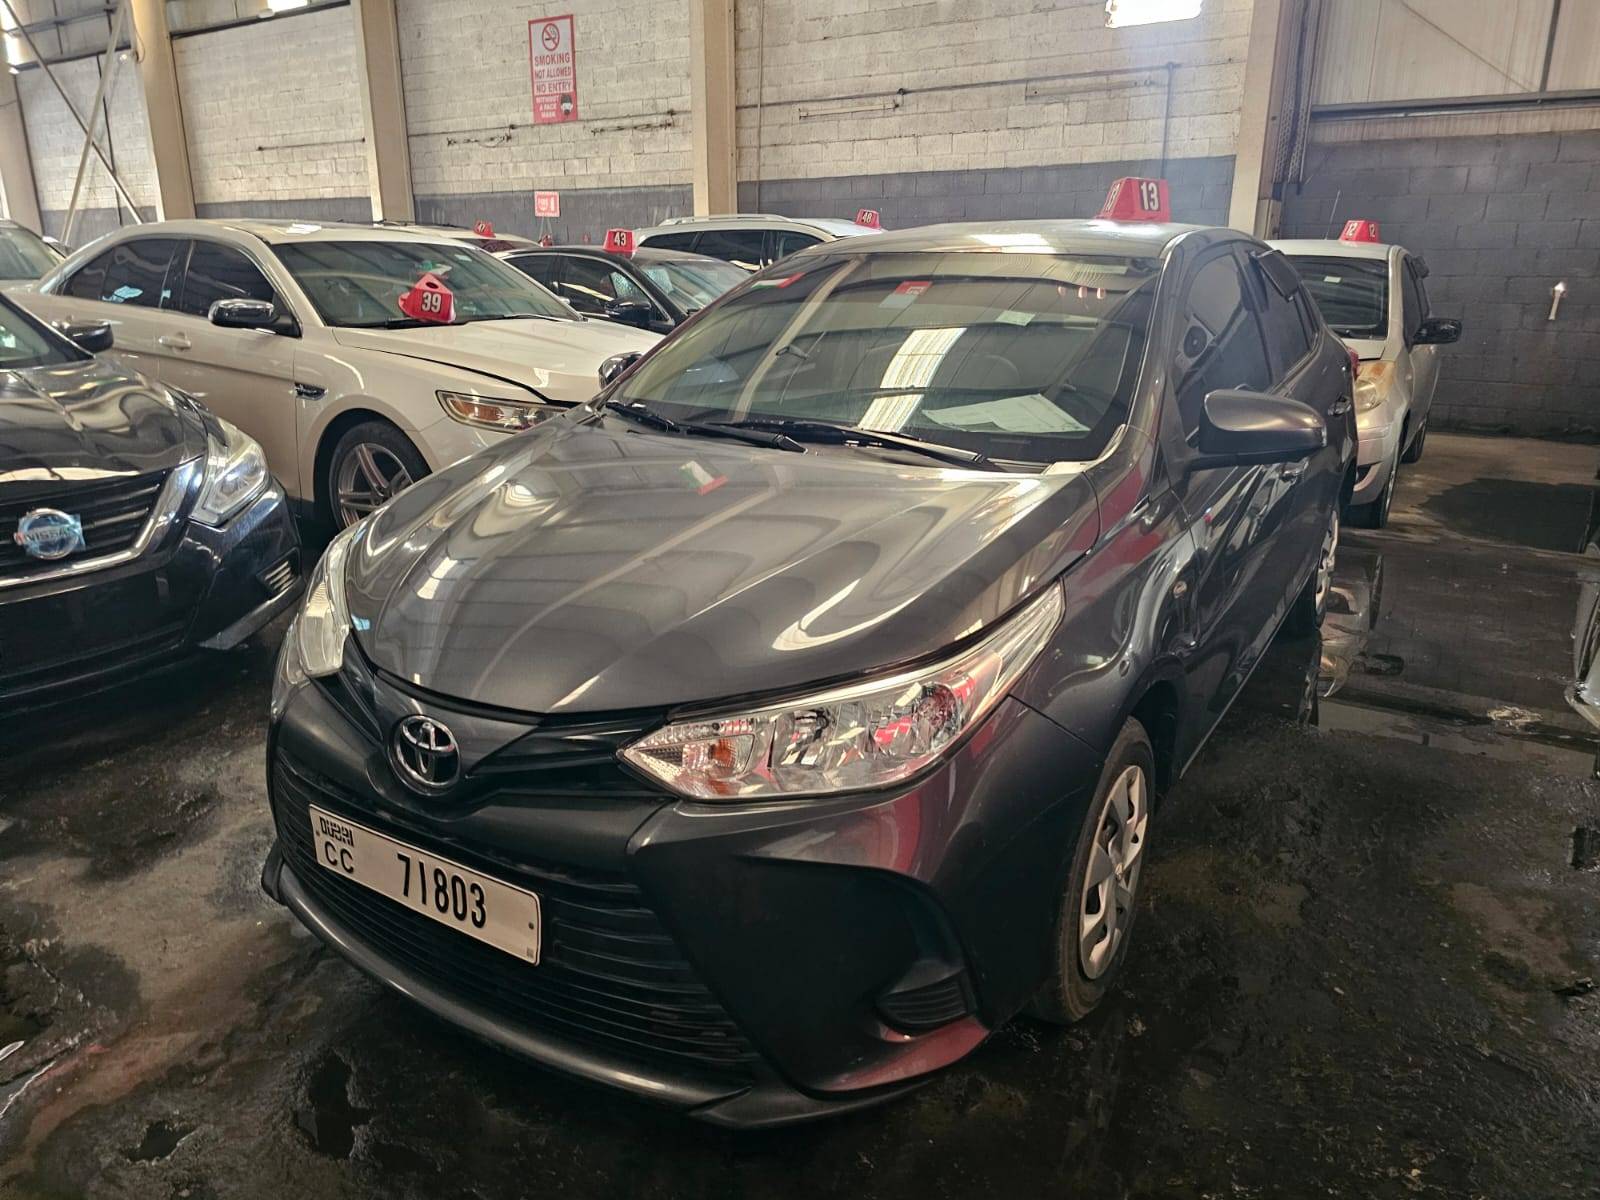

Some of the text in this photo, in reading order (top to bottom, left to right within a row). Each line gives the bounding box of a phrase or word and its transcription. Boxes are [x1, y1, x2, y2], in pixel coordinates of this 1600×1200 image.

[534, 53, 570, 66] SMOKING
[535, 67, 571, 79] NOT ALLOWED
[536, 81, 571, 93] NO ENTRY
[1140, 181, 1160, 211] 13
[614, 231, 626, 246] 43
[421, 291, 442, 313] 39
[324, 841, 354, 874] CC
[397, 851, 486, 929] 71803
